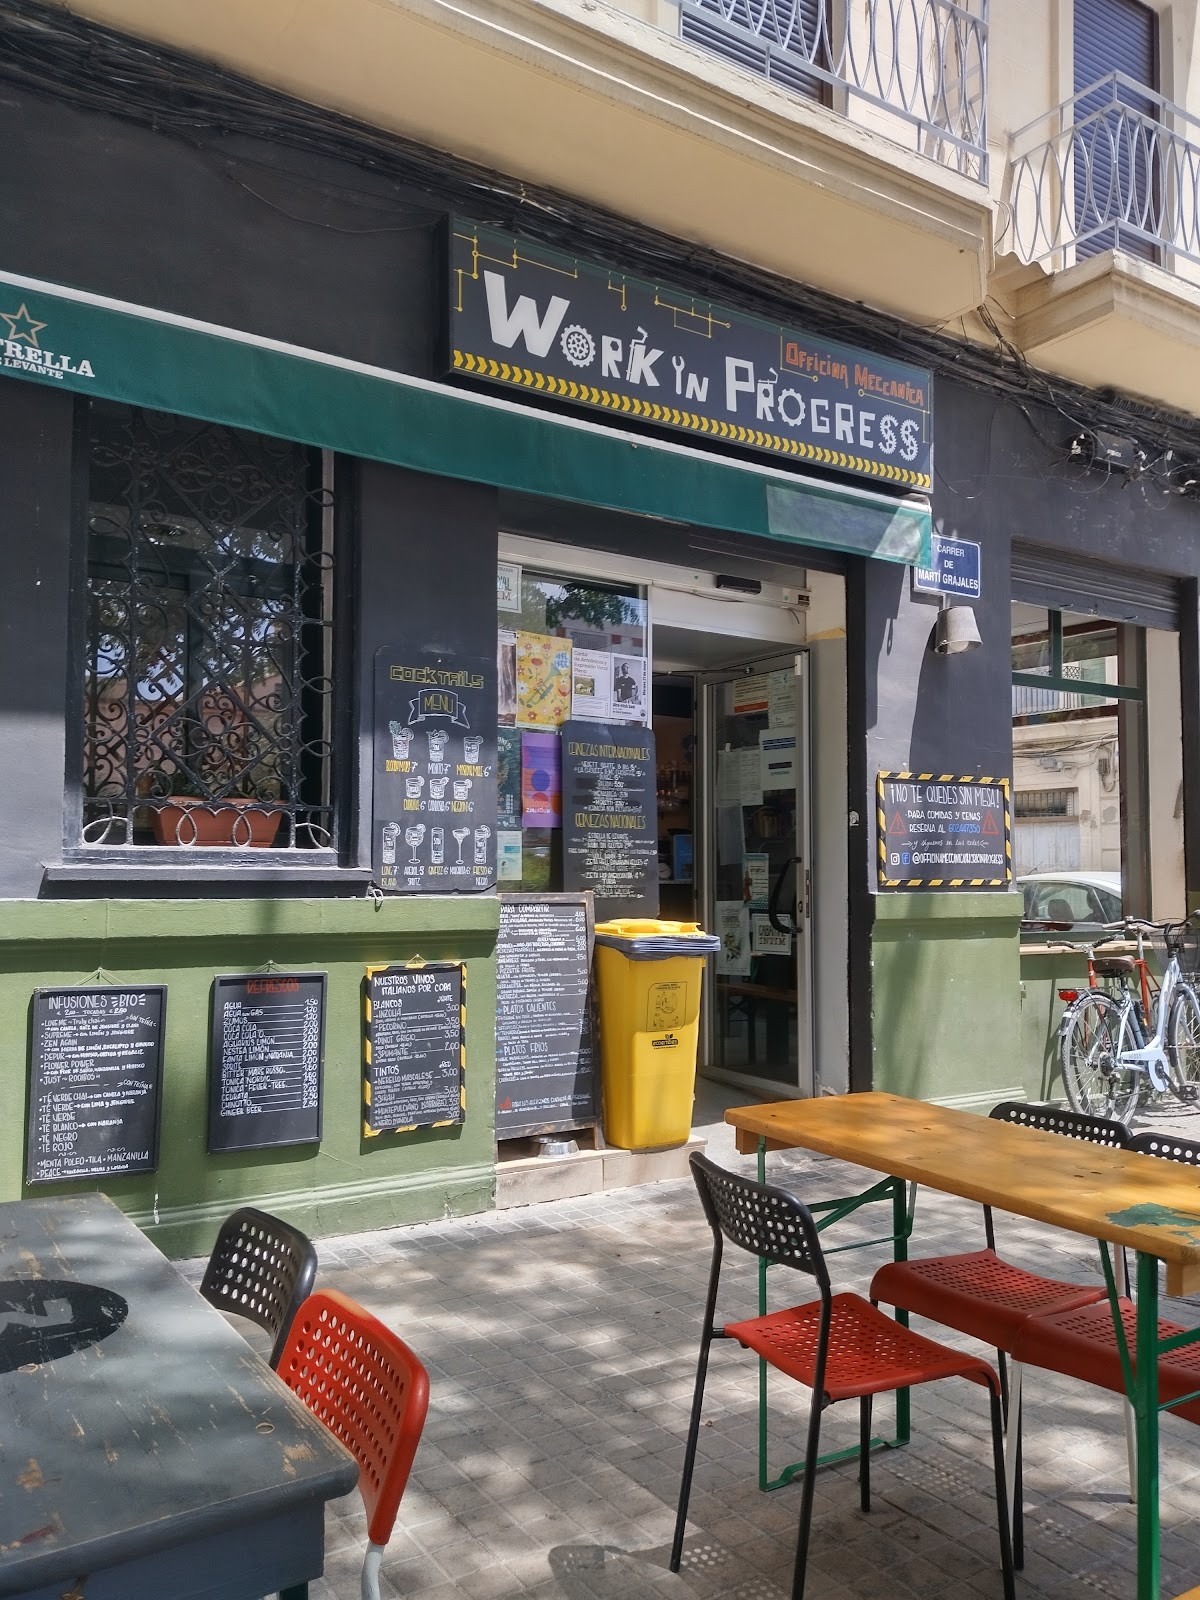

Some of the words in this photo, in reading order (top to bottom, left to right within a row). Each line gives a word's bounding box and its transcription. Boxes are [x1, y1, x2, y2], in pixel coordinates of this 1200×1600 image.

[0, 338, 96, 378] RELLA
[4, 358, 64, 379] LEVANTE
[483, 269, 665, 387] WORK
[671, 355, 709, 403] IN
[725, 356, 920, 462] PROGRESS
[936, 544, 965, 557] CARRER
[944, 560, 954, 569] DE
[918, 568, 941, 583] MARTÍ
[942, 574, 979, 590] GRAJALES
[390, 665, 484, 689] COCKTAILS
[424, 693, 454, 713] MENU
[910, 785, 923, 803] TE
[926, 785, 958, 805] QUEDES
[959, 786, 973, 806] SIN
[974, 787, 1000, 809] MESA!
[907, 809, 925, 819] PARA
[927, 810, 953, 820] COMIDAS
[961, 811, 981, 821] CENAS
[909, 824, 936, 833] RESERVA
[938, 824, 947, 833] AL
[374, 975, 408, 987] NUESTROS
[412, 974, 436, 984] VINOS
[381, 985, 416, 995] ITALIANOS
[418, 984, 431, 993] POR
[434, 983, 452, 992] COPA
[48, 994, 108, 1010] INFUSIONES
[119, 994, 138, 1007] BIO
[223, 1001, 242, 1010] AGUA
[373, 999, 403, 1010] BLANCOS
[503, 1004, 524, 1015] PLATOS
[526, 1001, 557, 1013] CALIENTES
[223, 1010, 242, 1018] AGUA
[223, 1017, 248, 1026] ZUMOS
[223, 1025, 240, 1033] COCA
[241, 1024, 257, 1032] COLA
[44, 1031, 72, 1039] SUPREME
[223, 1032, 240, 1040] COCA
[241, 1031, 257, 1039] COLA
[395, 1034, 416, 1043] GRIGIO
[43, 1039, 58, 1047] ZEN
[223, 1039, 255, 1048] AGUARIUS
[223, 1047, 247, 1056] NESTEA
[504, 1044, 527, 1056] PLATOS
[44, 1052, 65, 1061] DEPUR
[222, 1055, 243, 1063] FANTA
[43, 1061, 69, 1070] FLOWER
[71, 1059, 95, 1068] POWER
[373, 1065, 400, 1077] TINTOS
[43, 1075, 61, 1085] JUST
[42, 1091, 53, 1103] TÉ
[53, 1093, 73, 1102] VERDE
[41, 1103, 51, 1113] TÉ
[53, 1103, 74, 1112] VERDE
[220, 1108, 244, 1117] GINGER
[246, 1106, 263, 1114] BEER
[41, 1113, 51, 1123] TÉ
[53, 1112, 76, 1122] VERDE
[53, 1122, 78, 1132] BLANCO
[53, 1132, 78, 1142] NEGRO
[53, 1142, 74, 1152] ROJO
[40, 1158, 62, 1169] MENTA
[63, 1156, 85, 1167] POLEO
[88, 1155, 102, 1164] TILA
[107, 1151, 149, 1163] MANZANILLA
[40, 1168, 62, 1178] PEACE
